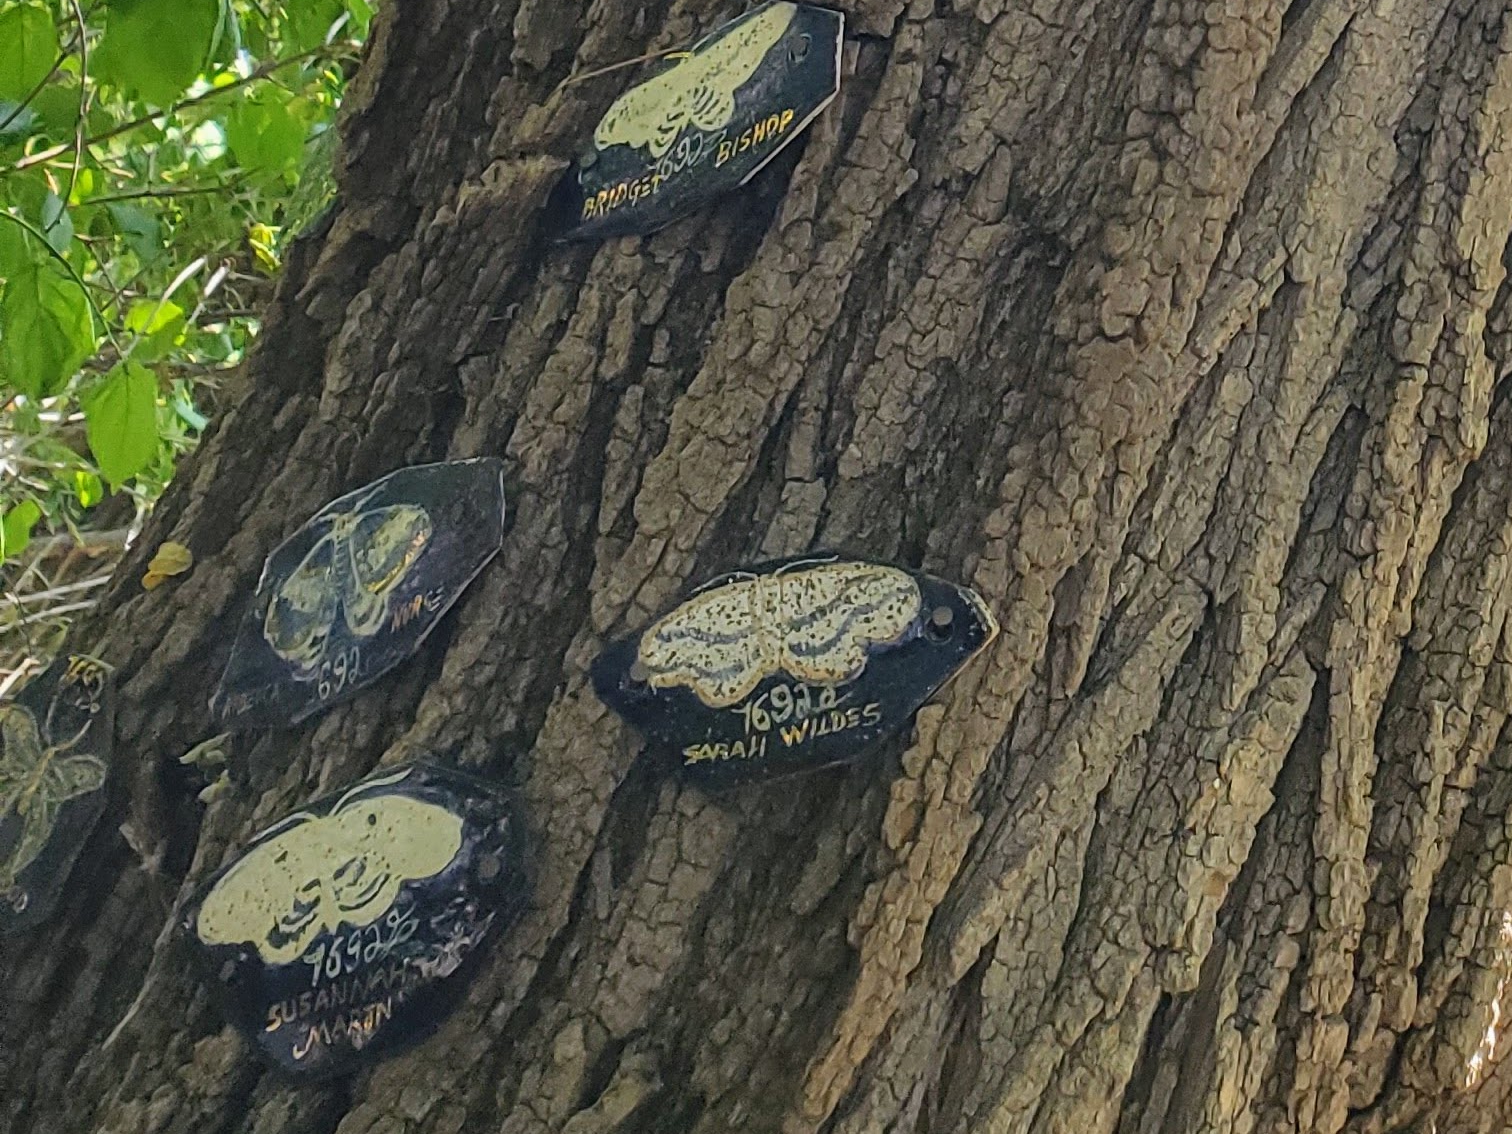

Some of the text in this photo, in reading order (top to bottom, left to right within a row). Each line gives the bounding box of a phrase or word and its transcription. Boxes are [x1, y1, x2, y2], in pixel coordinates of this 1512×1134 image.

[715, 108, 794, 168] BISHOP
[581, 173, 663, 220] BRIDGET
[684, 702, 881, 766] SARAH WILDES
[265, 957, 410, 1033] SUSANNAH
